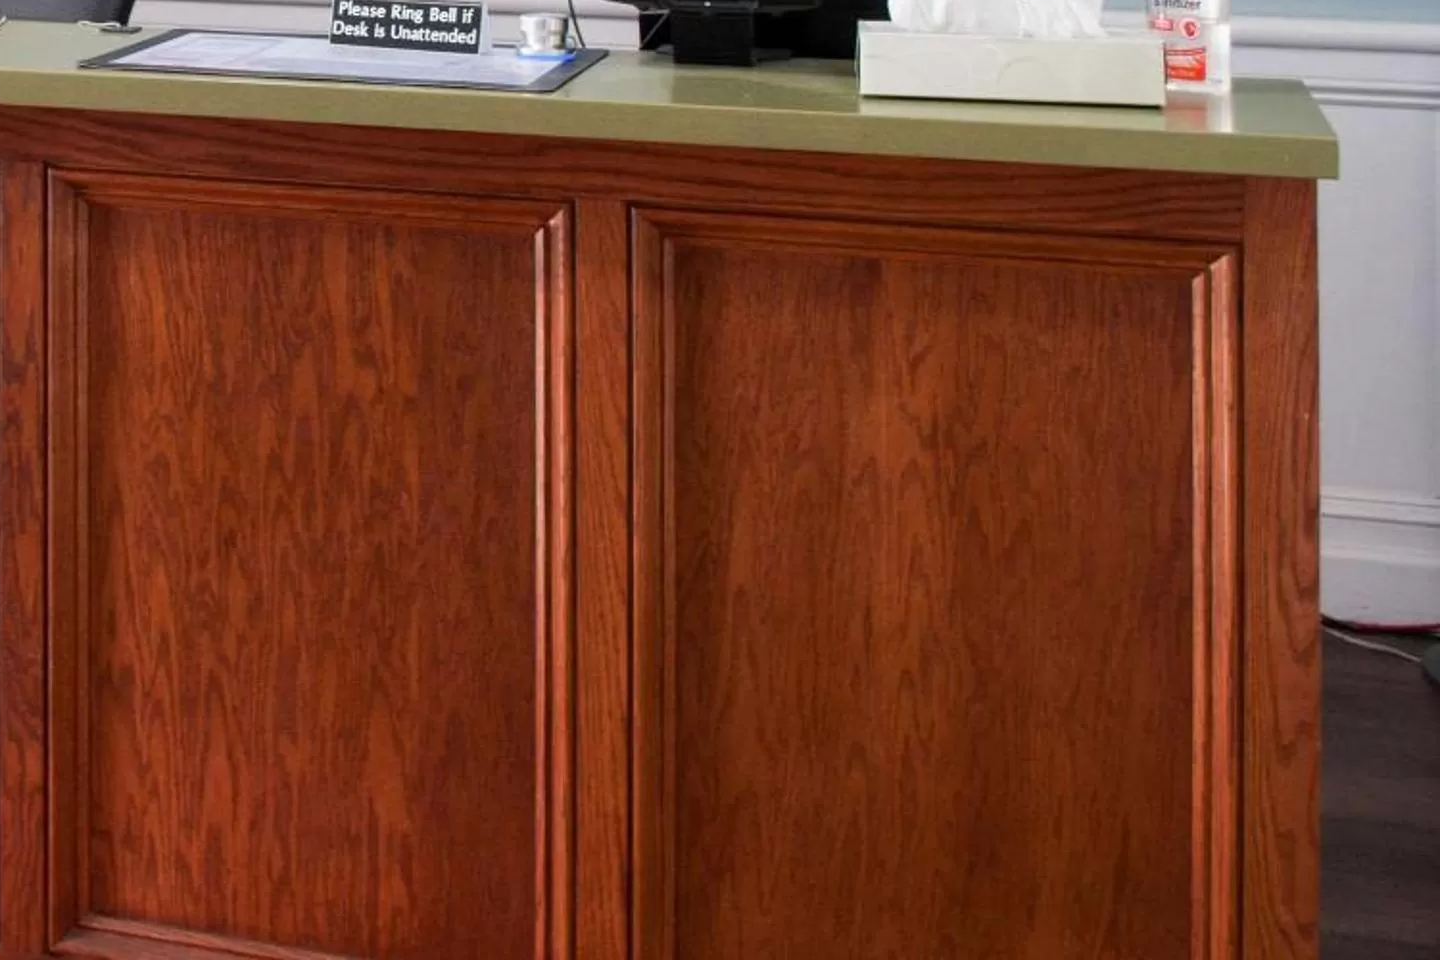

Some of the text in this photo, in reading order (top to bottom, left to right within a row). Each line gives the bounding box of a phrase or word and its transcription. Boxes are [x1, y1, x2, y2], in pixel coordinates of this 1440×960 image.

[338, 0, 475, 24] Please Ring Bell if
[332, 20, 478, 45] Desk is Unattended
